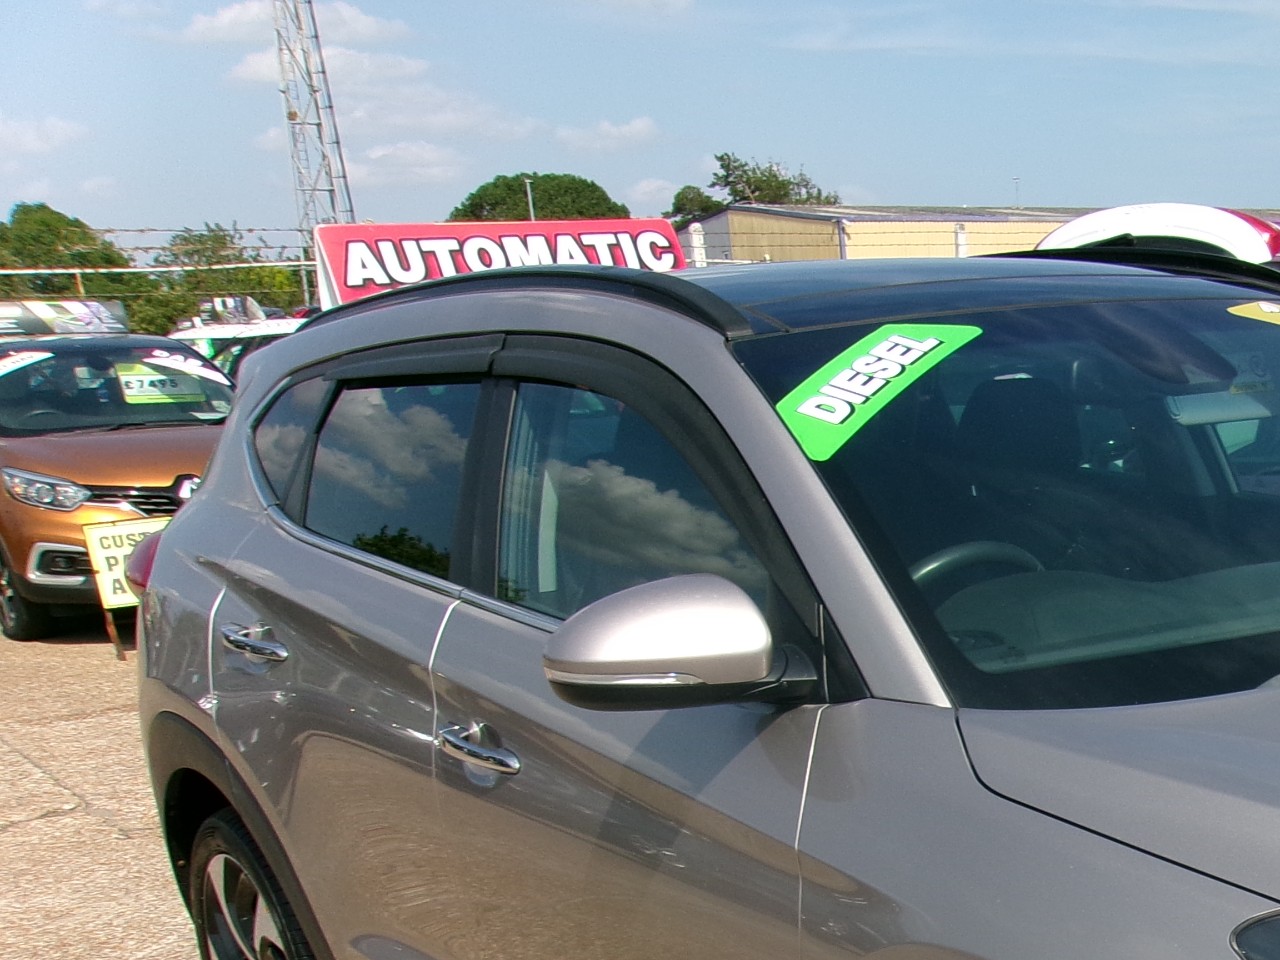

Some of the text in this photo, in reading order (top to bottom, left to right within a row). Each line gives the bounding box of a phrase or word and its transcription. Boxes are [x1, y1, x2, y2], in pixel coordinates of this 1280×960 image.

[345, 231, 677, 287] AUTOMATIC
[124, 378, 179, 390] £7495
[795, 335, 945, 425] DIESEL
